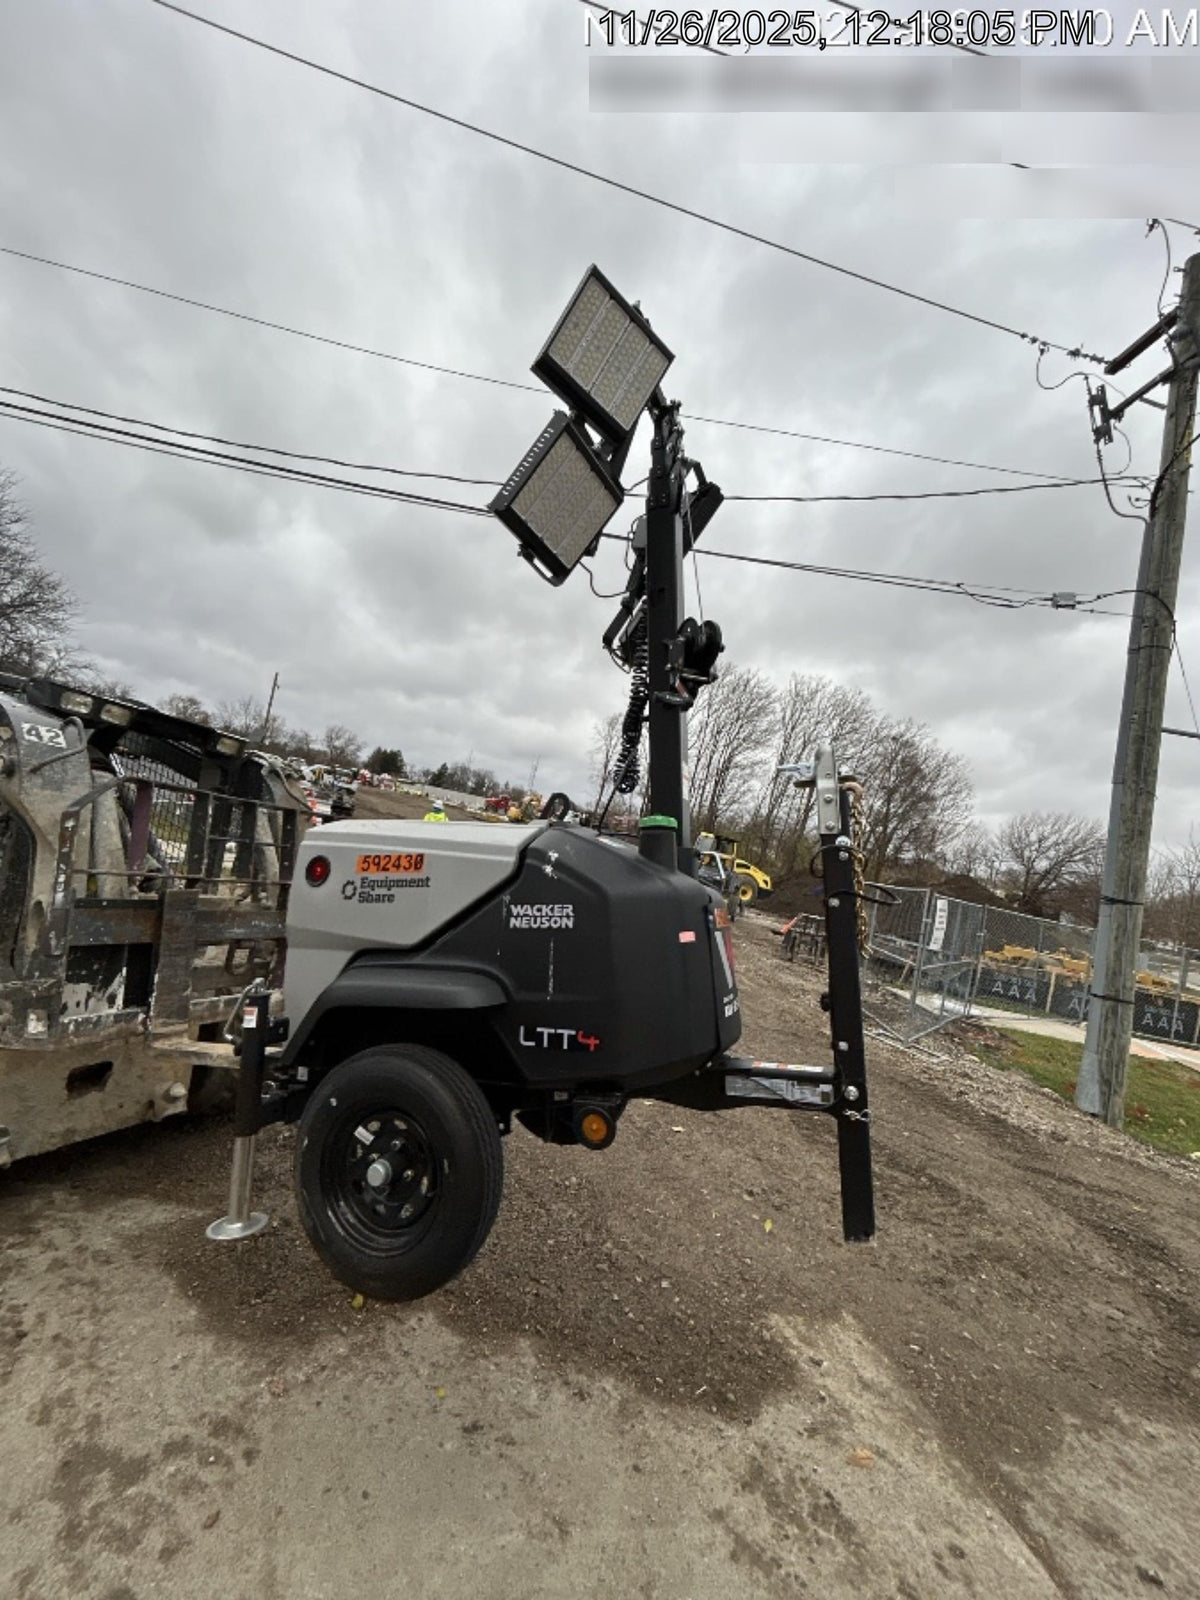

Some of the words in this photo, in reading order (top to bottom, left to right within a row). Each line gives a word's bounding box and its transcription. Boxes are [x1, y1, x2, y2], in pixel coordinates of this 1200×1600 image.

[23, 722, 65, 747] 42
[360, 853, 425, 873] 592430
[360, 876, 431, 891] Equipment
[358, 891, 396, 904] Share
[510, 904, 575, 917] WACKER
[509, 916, 575, 929] NEUSON
[518, 1025, 600, 1052] LTT4
